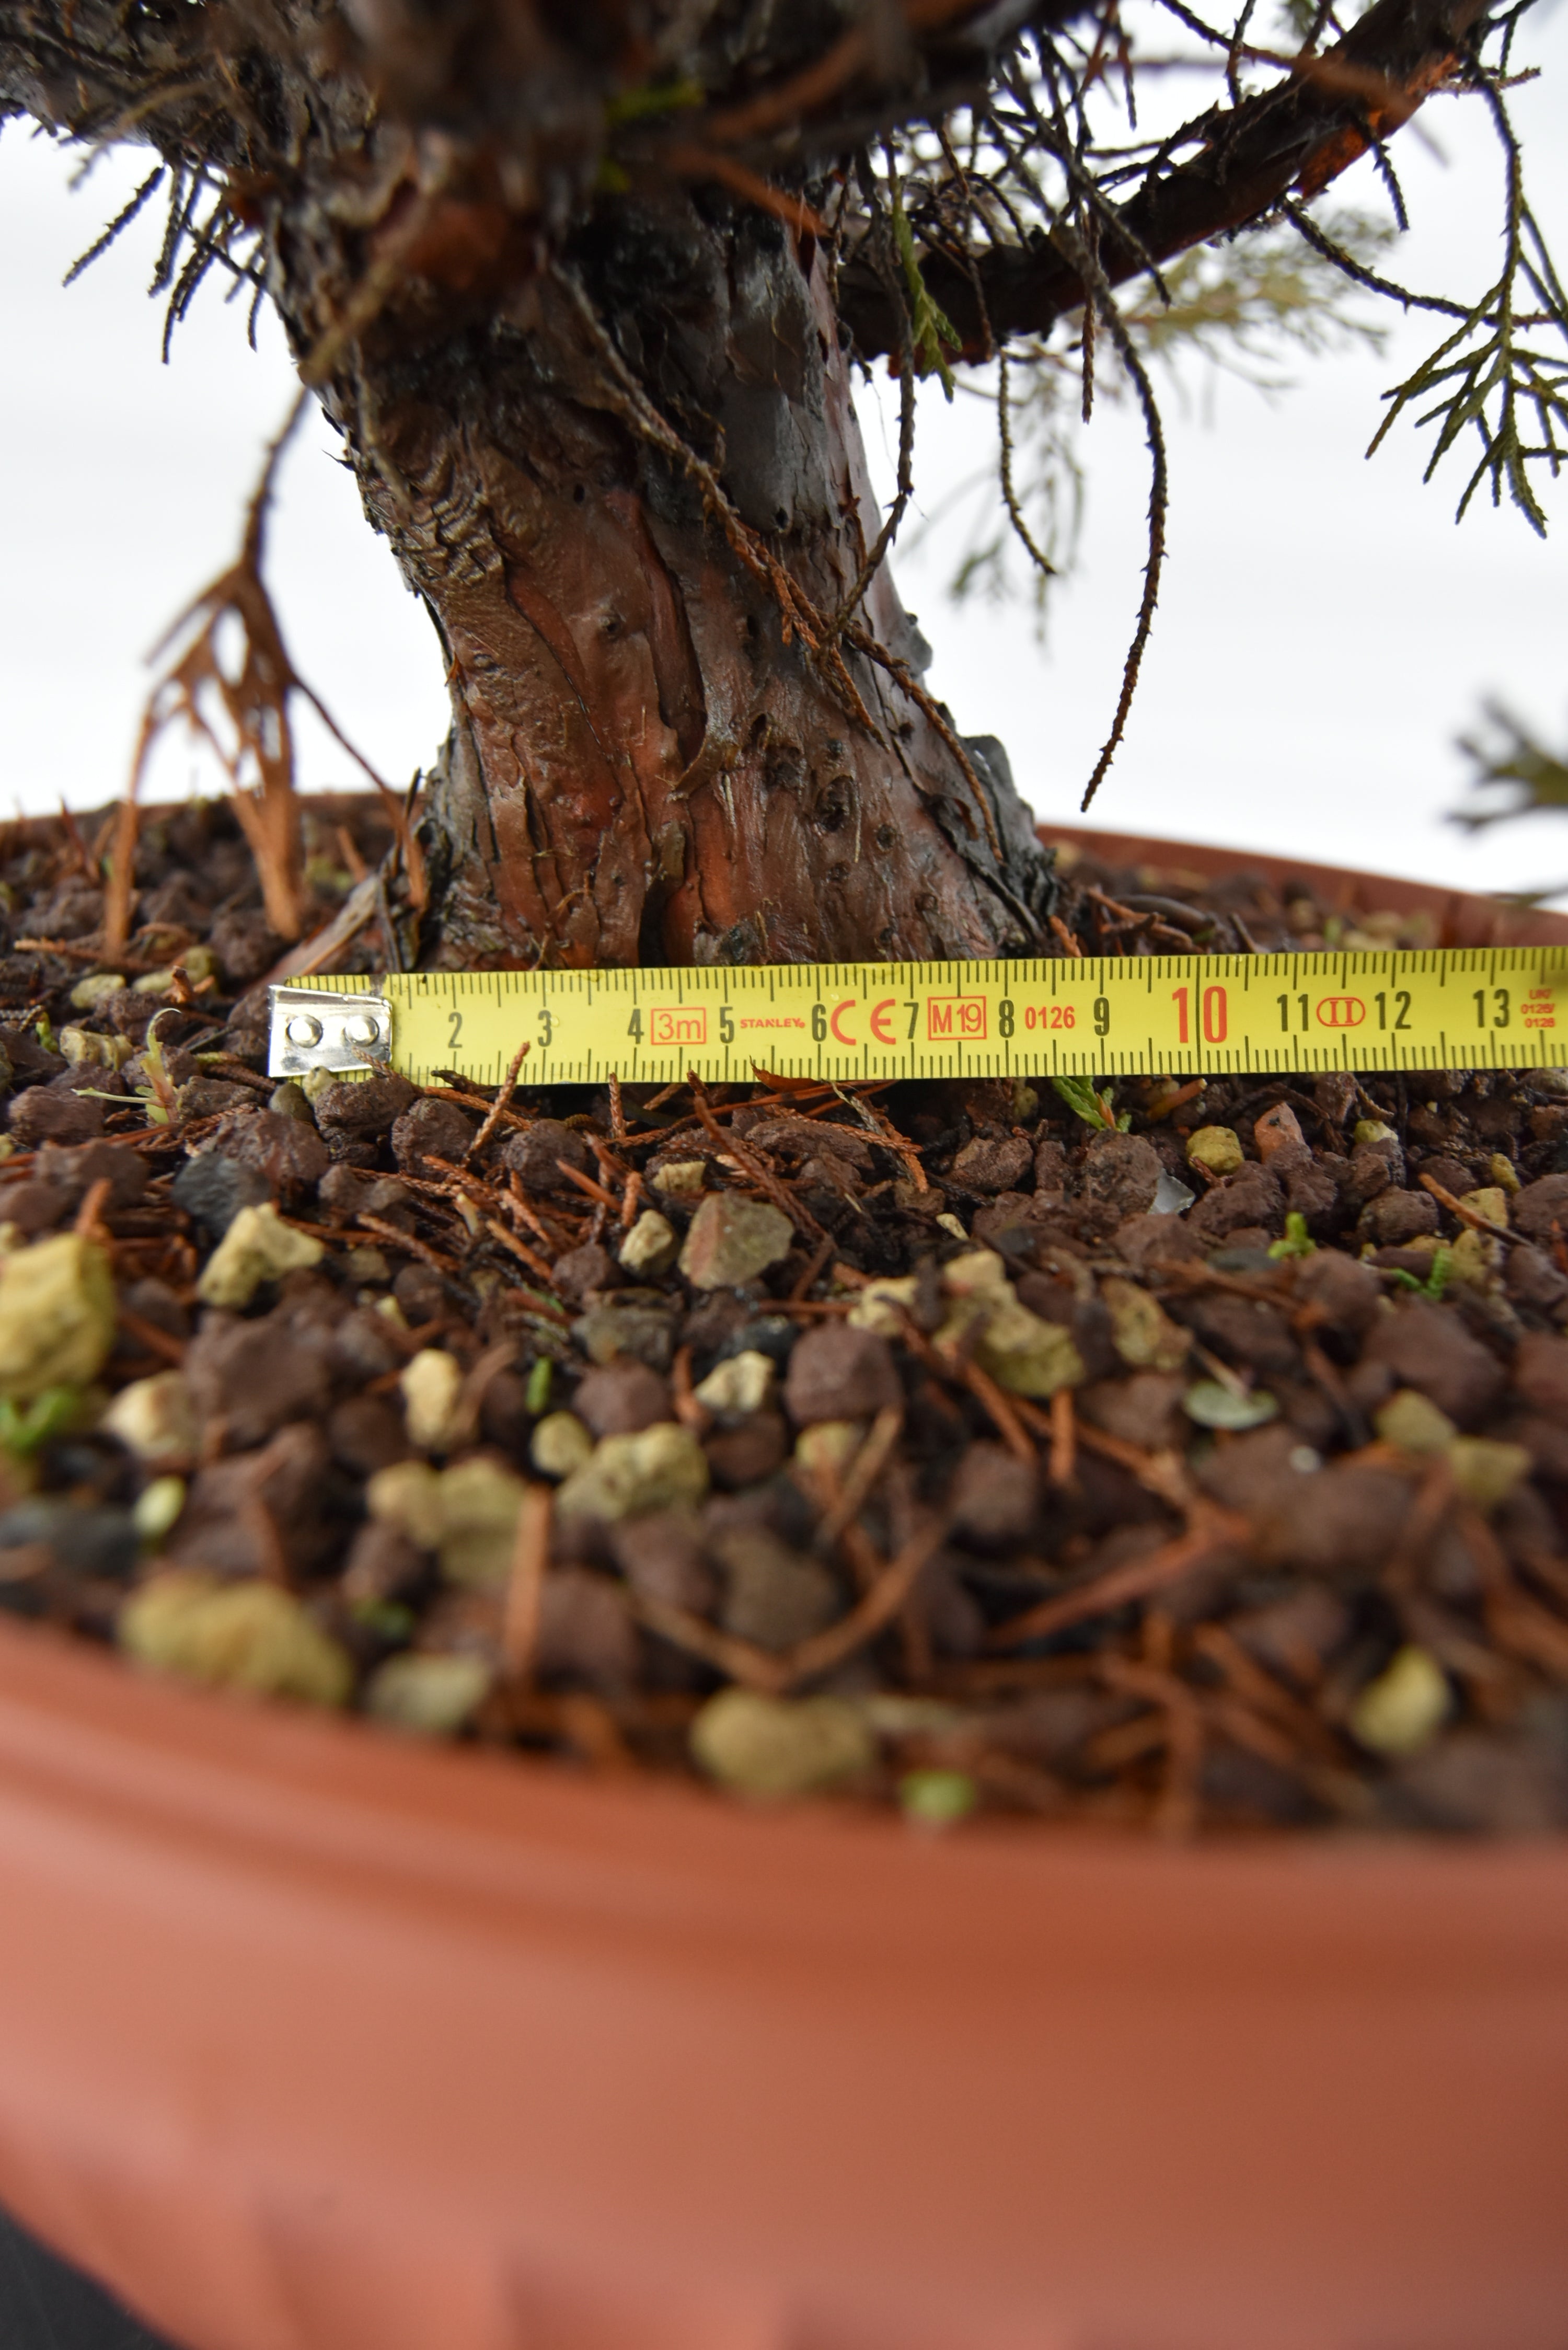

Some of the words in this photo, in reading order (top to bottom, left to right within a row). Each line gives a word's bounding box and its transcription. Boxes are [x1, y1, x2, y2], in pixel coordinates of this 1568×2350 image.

[627, 1009, 644, 1044] 4
[658, 1013, 702, 1040] 3m
[720, 1007, 735, 1043] 5
[740, 1018, 801, 1029] STANLEY
[811, 1004, 827, 1042] 6
[904, 1002, 919, 1039] 7
[998, 999, 1014, 1038] 8
[1025, 1006, 1076, 1029] 0126
[1094, 997, 1110, 1036] 9
[1172, 986, 1228, 1043] 10
[1277, 994, 1309, 1032] 11
[1375, 991, 1411, 1030] 12
[1473, 989, 1509, 1028] 13
[448, 1012, 463, 1049] 2
[537, 1010, 552, 1047] 3
